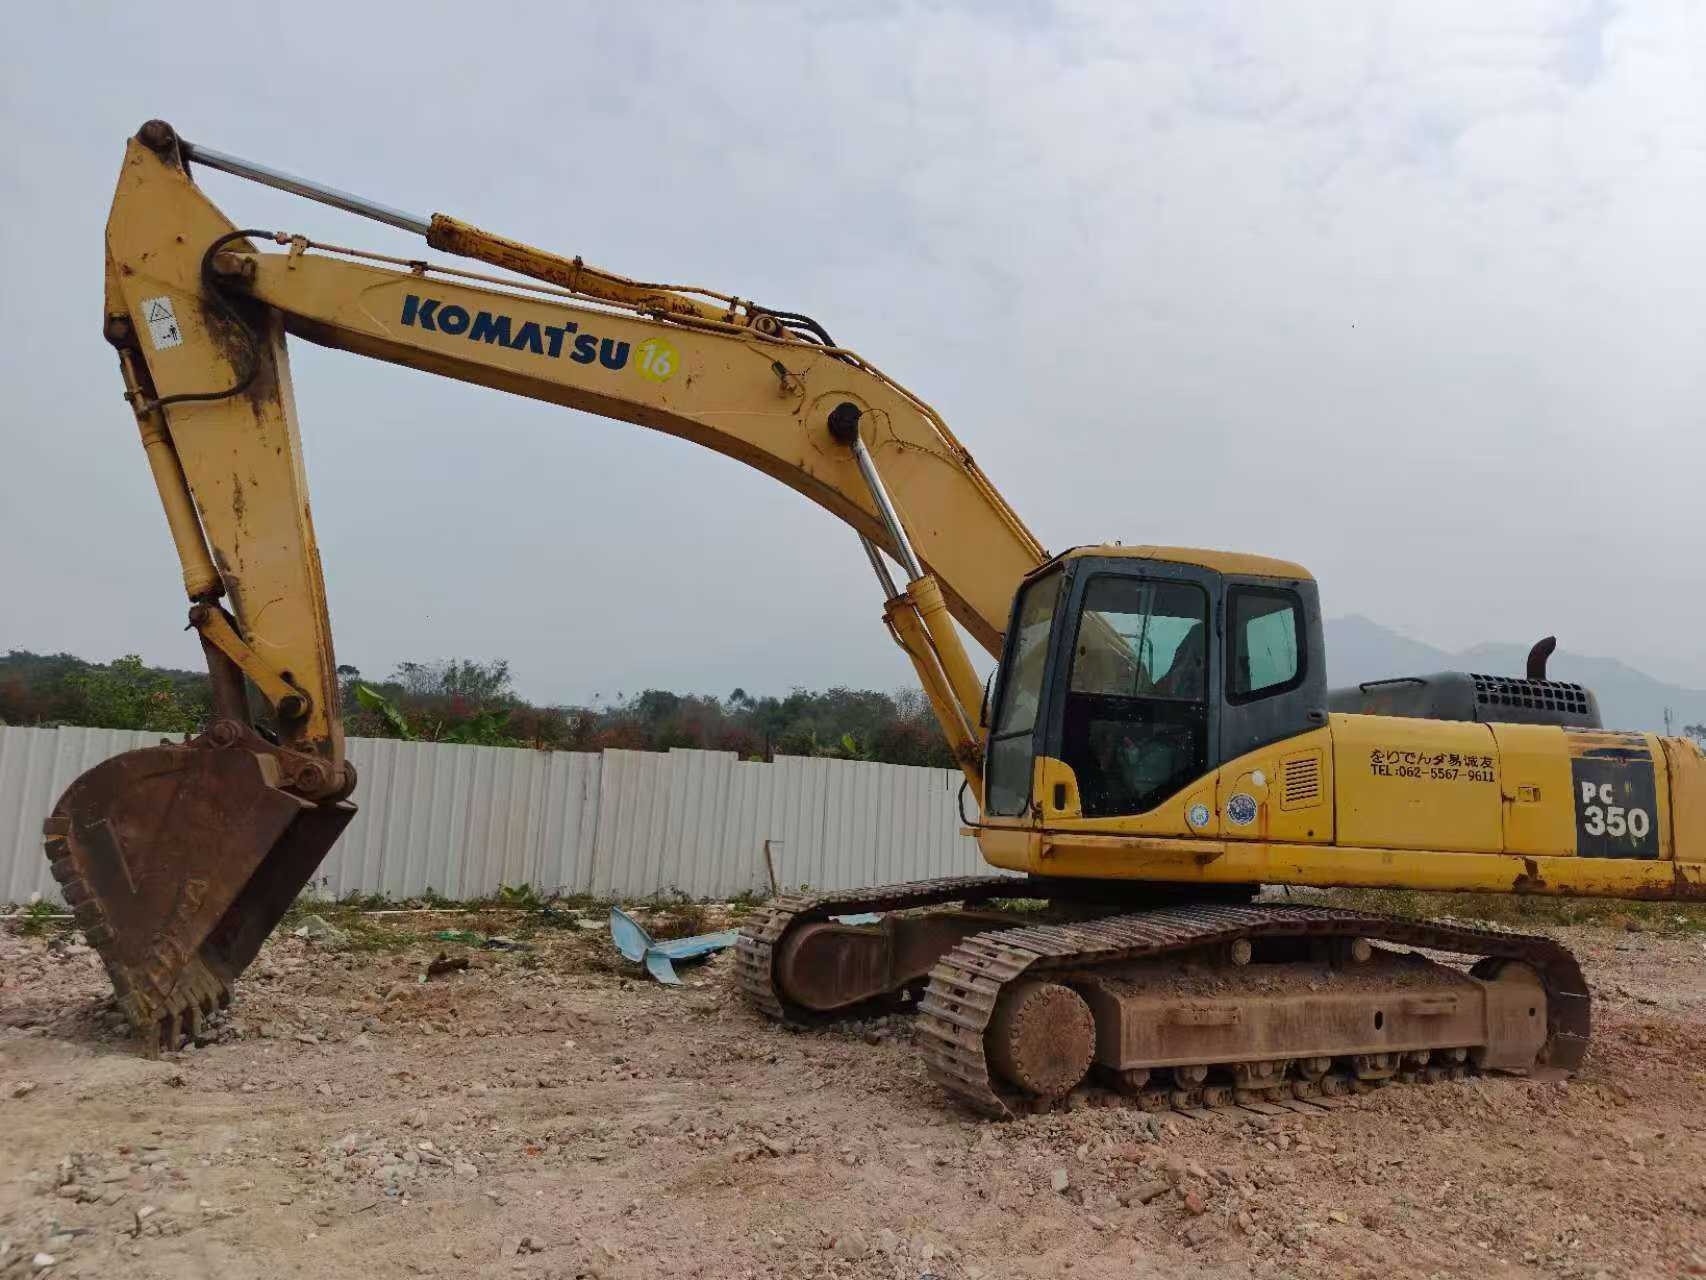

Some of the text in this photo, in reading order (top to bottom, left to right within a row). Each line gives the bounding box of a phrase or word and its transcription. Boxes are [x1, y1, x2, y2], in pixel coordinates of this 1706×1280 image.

[401, 294, 630, 370] KOMATSU
[642, 343, 671, 377] 16
[1582, 781, 1613, 804] PC
[1584, 805, 1650, 838] 350
